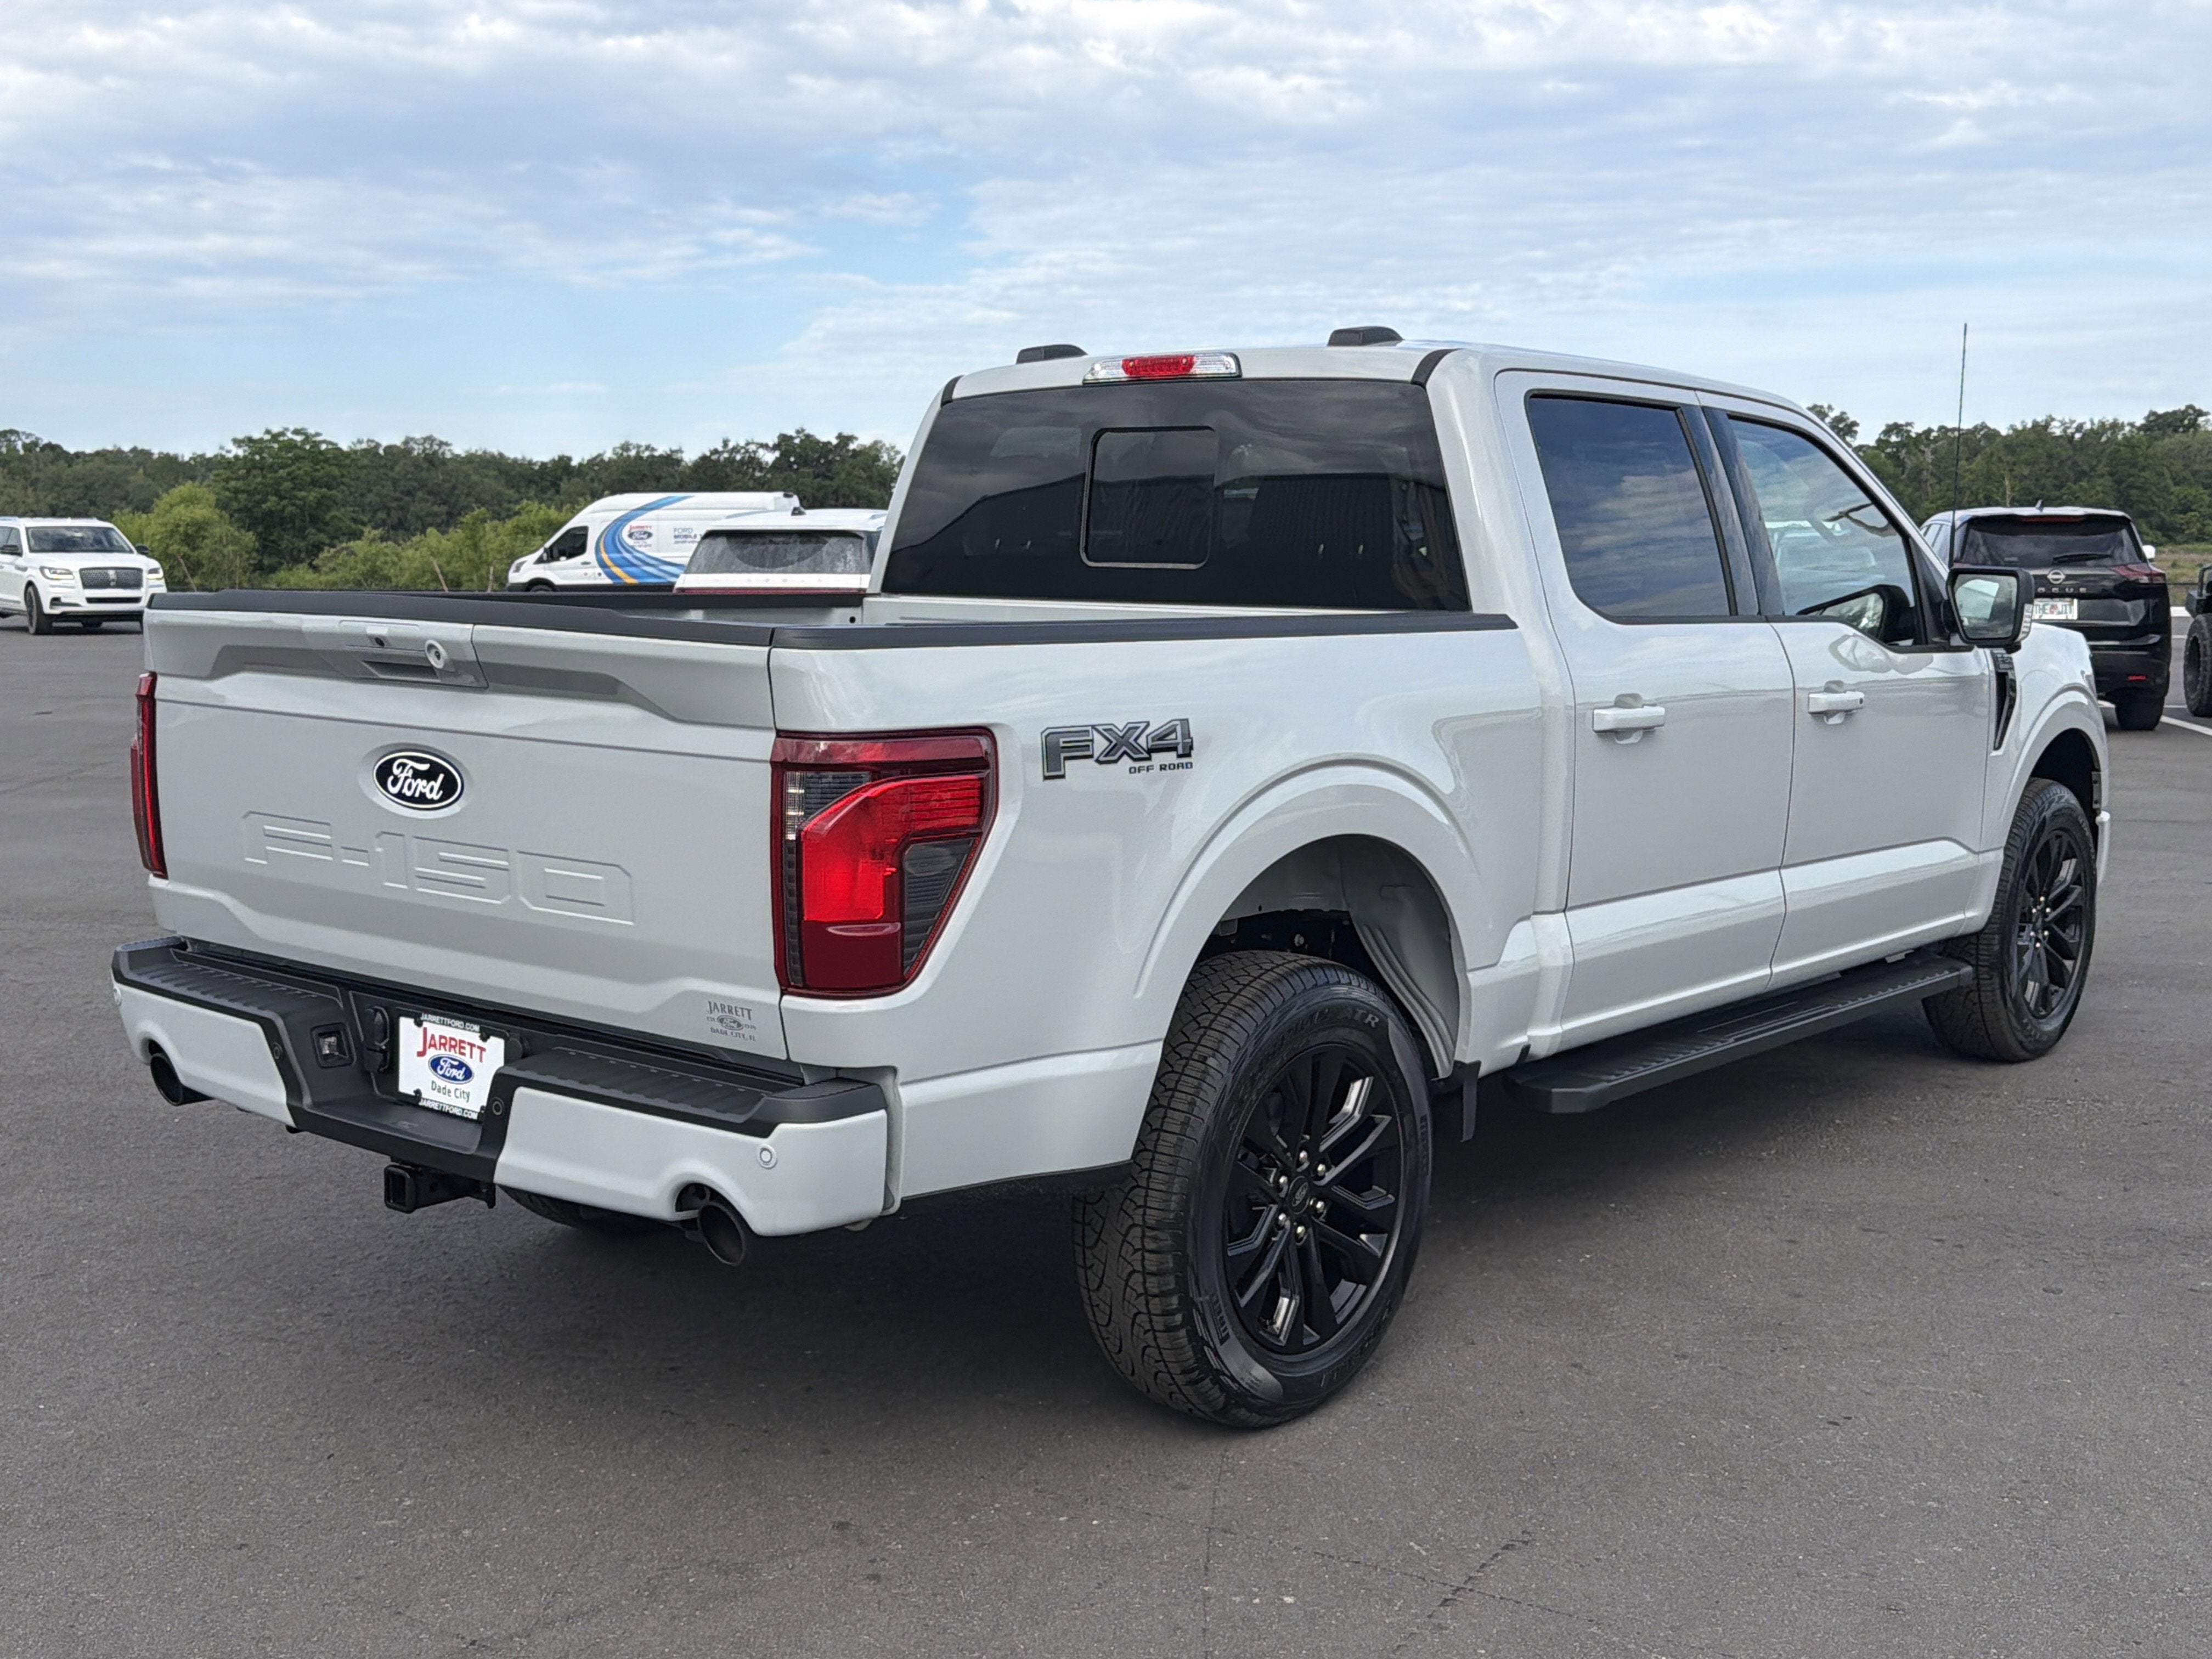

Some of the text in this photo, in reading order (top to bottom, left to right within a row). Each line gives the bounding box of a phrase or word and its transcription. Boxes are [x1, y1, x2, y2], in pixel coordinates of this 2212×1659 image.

[1041, 718, 1193, 781] FX4
[1129, 761, 1193, 774] OFF ROAD
[387, 758, 445, 800] Ford
[241, 811, 635, 926] F-150
[707, 1001, 752, 1021] JARRETT
[420, 1013, 480, 1032] JARRETTFORD.COM
[416, 1027, 486, 1063] JARRETT
[437, 1058, 465, 1080] Ford
[431, 1080, 470, 1103] Dade City
[419, 1098, 478, 1120] JARRETTFORD.COM
